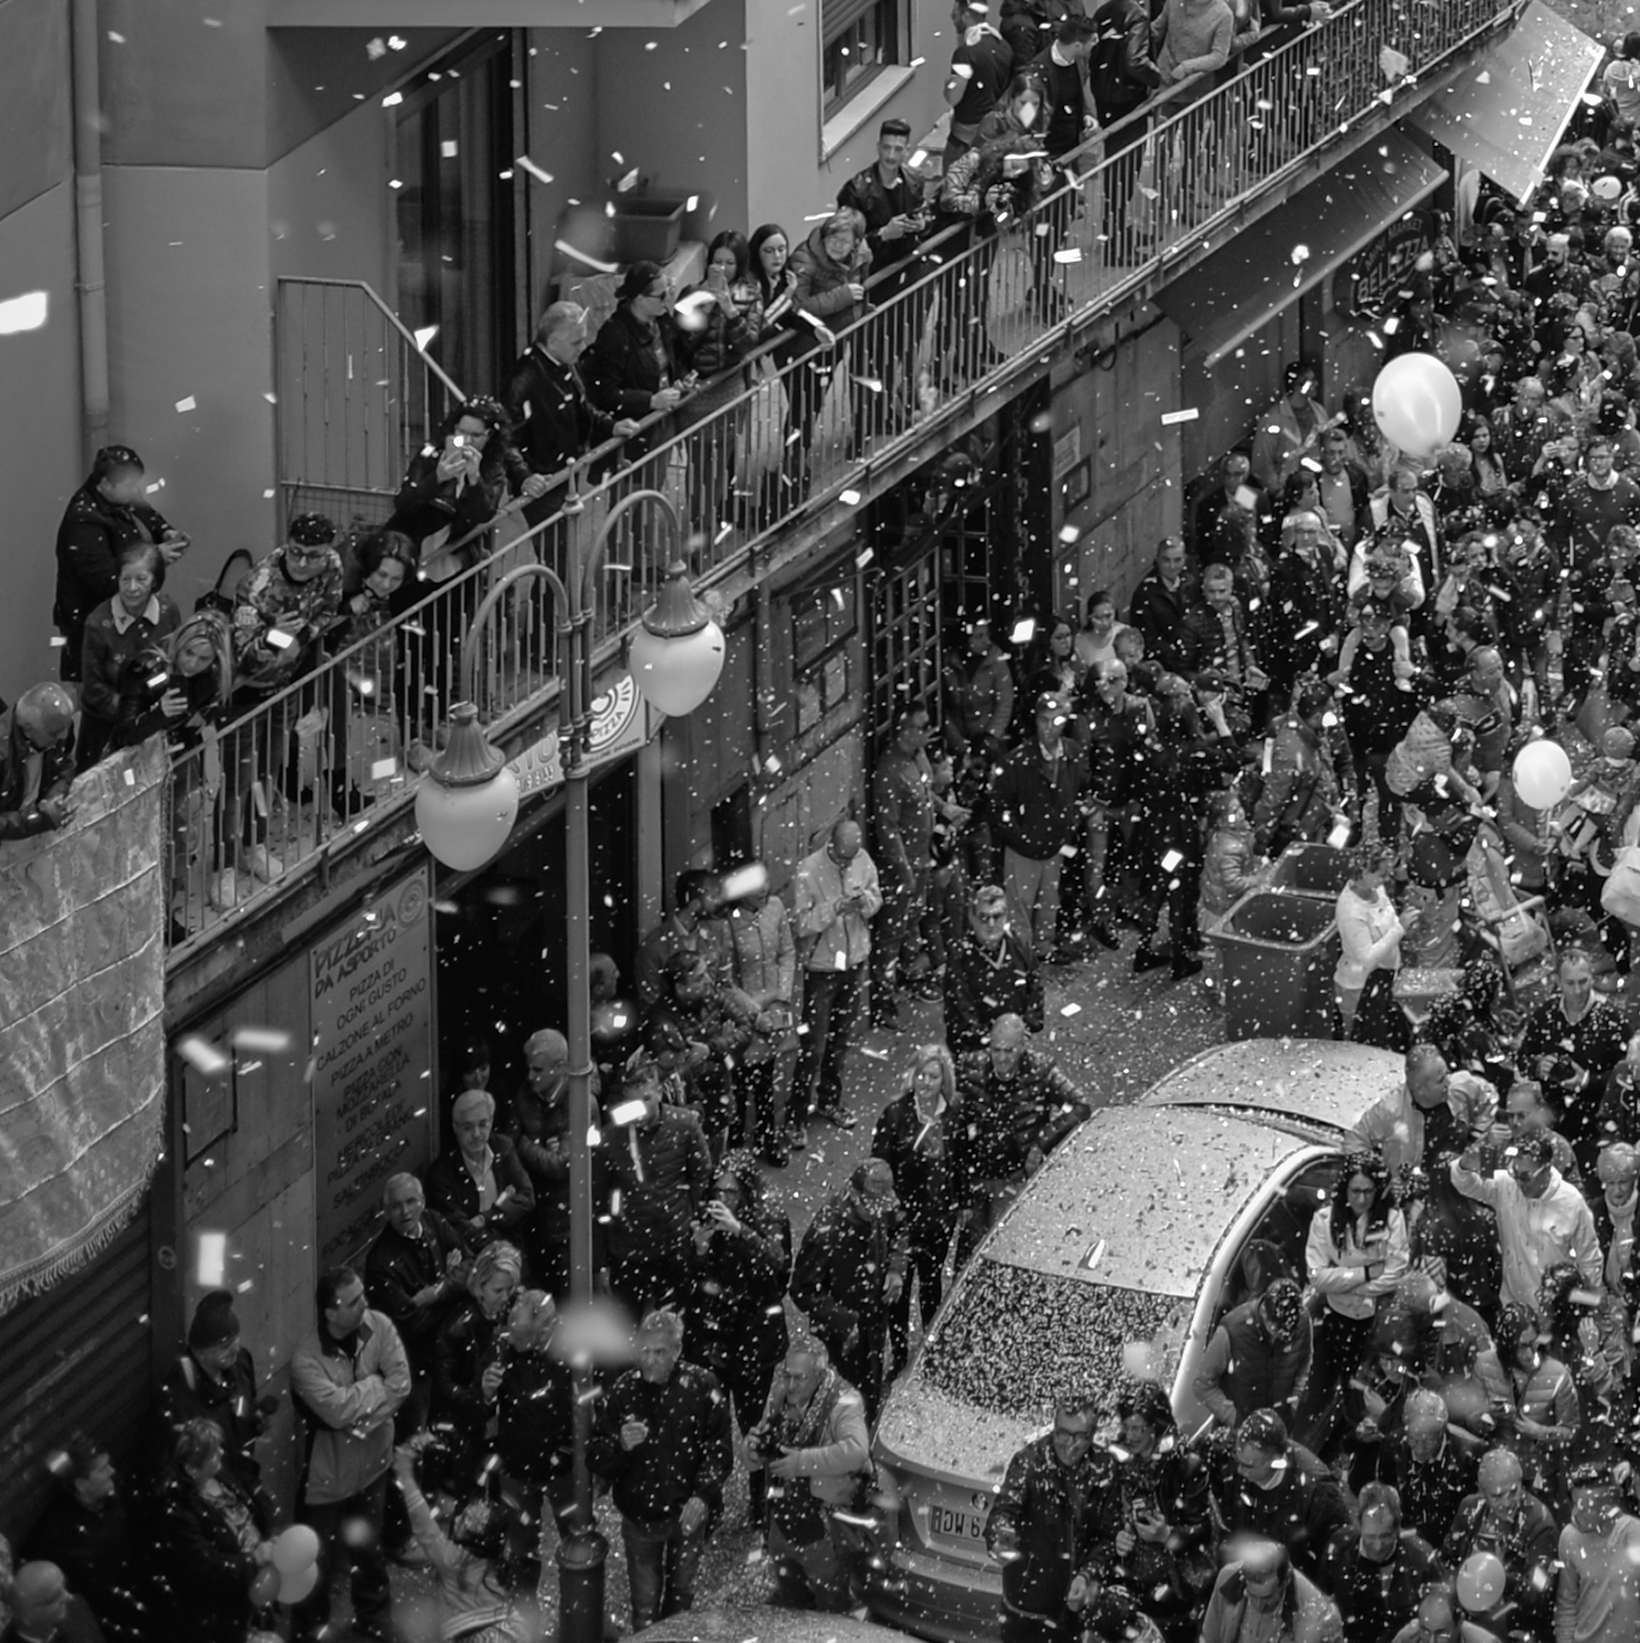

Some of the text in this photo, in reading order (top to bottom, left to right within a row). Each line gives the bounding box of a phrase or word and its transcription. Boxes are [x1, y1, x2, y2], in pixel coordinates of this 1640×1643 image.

[315, 927, 397, 1000] DA ASPORTO
[350, 958, 395, 1002] PIZZA DI
[316, 977, 426, 1072] CALZONE AL FORNO
[336, 967, 407, 1031] OGNI GUSTO
[331, 1054, 364, 1087] PIZZA
